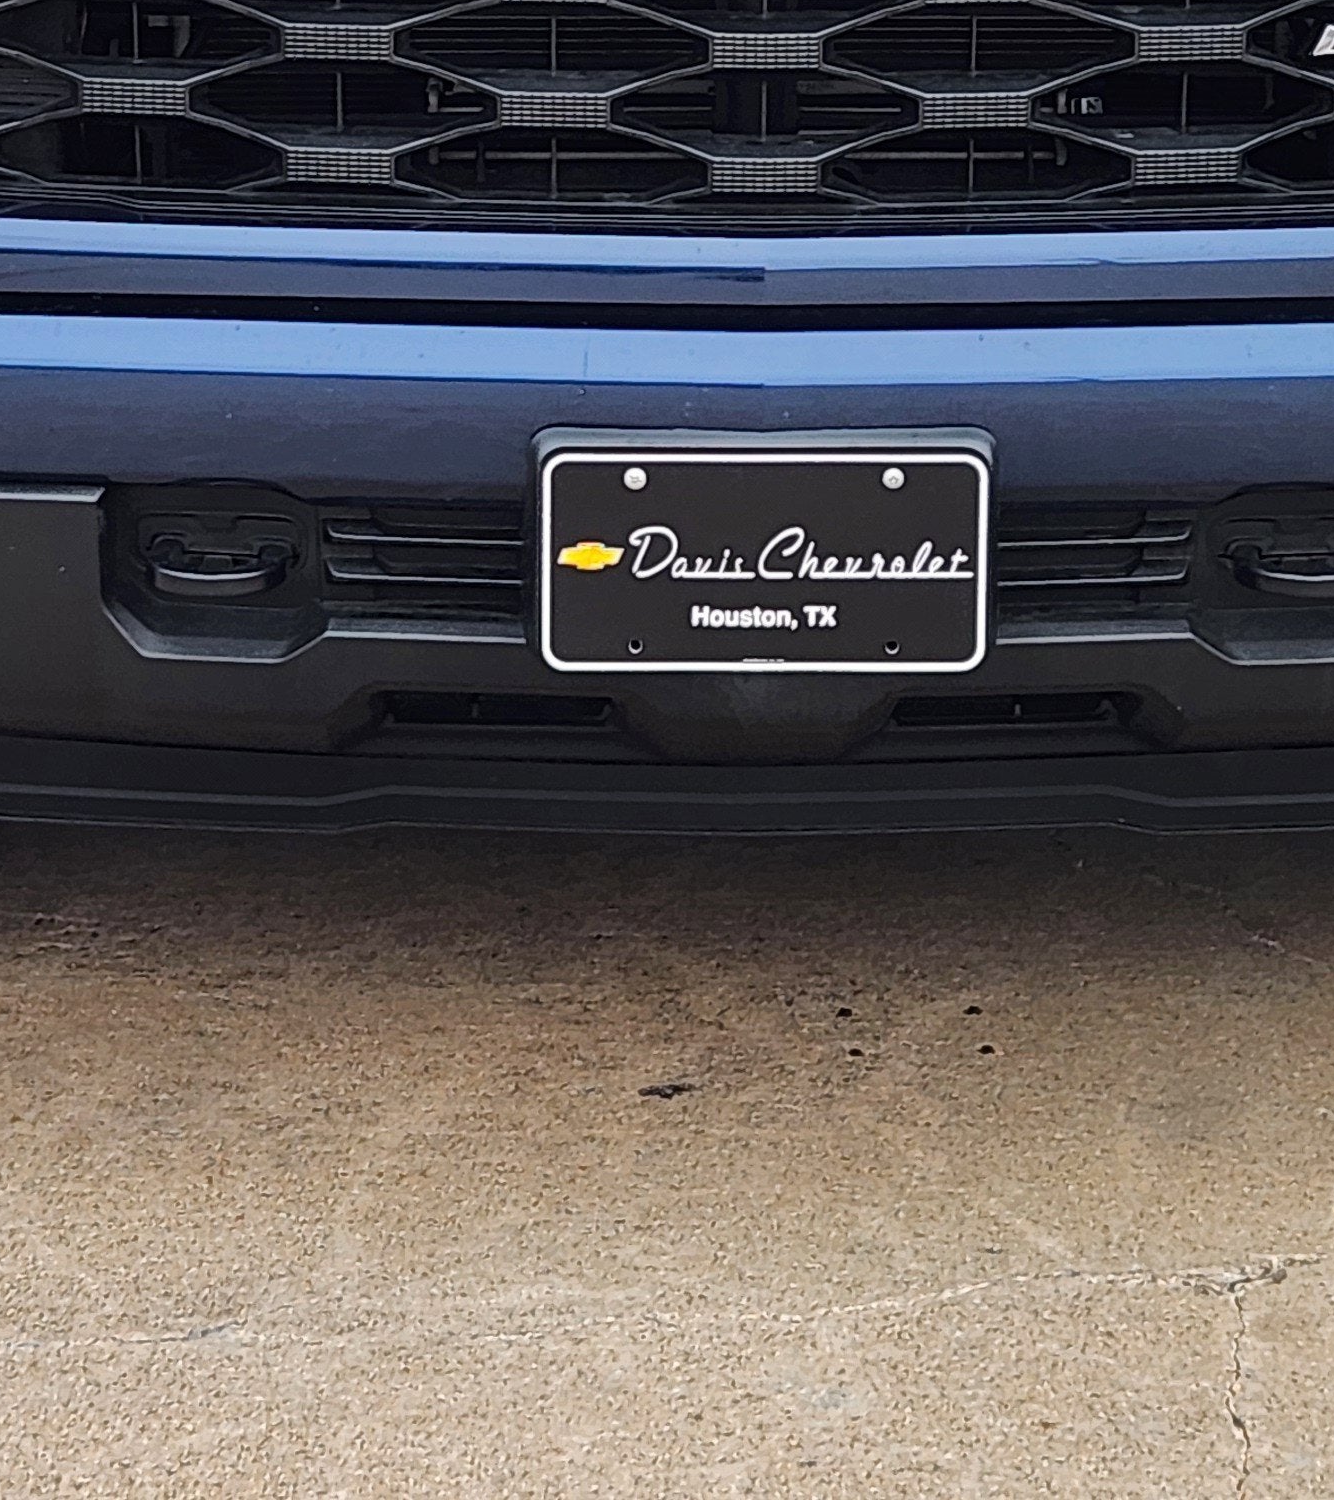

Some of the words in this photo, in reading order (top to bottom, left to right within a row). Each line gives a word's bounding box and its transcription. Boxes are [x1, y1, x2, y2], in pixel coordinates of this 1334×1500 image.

[628, 525, 756, 579] Davis
[757, 526, 975, 580] Chevrolet
[690, 605, 799, 630] Houston,
[803, 605, 837, 627] TX
